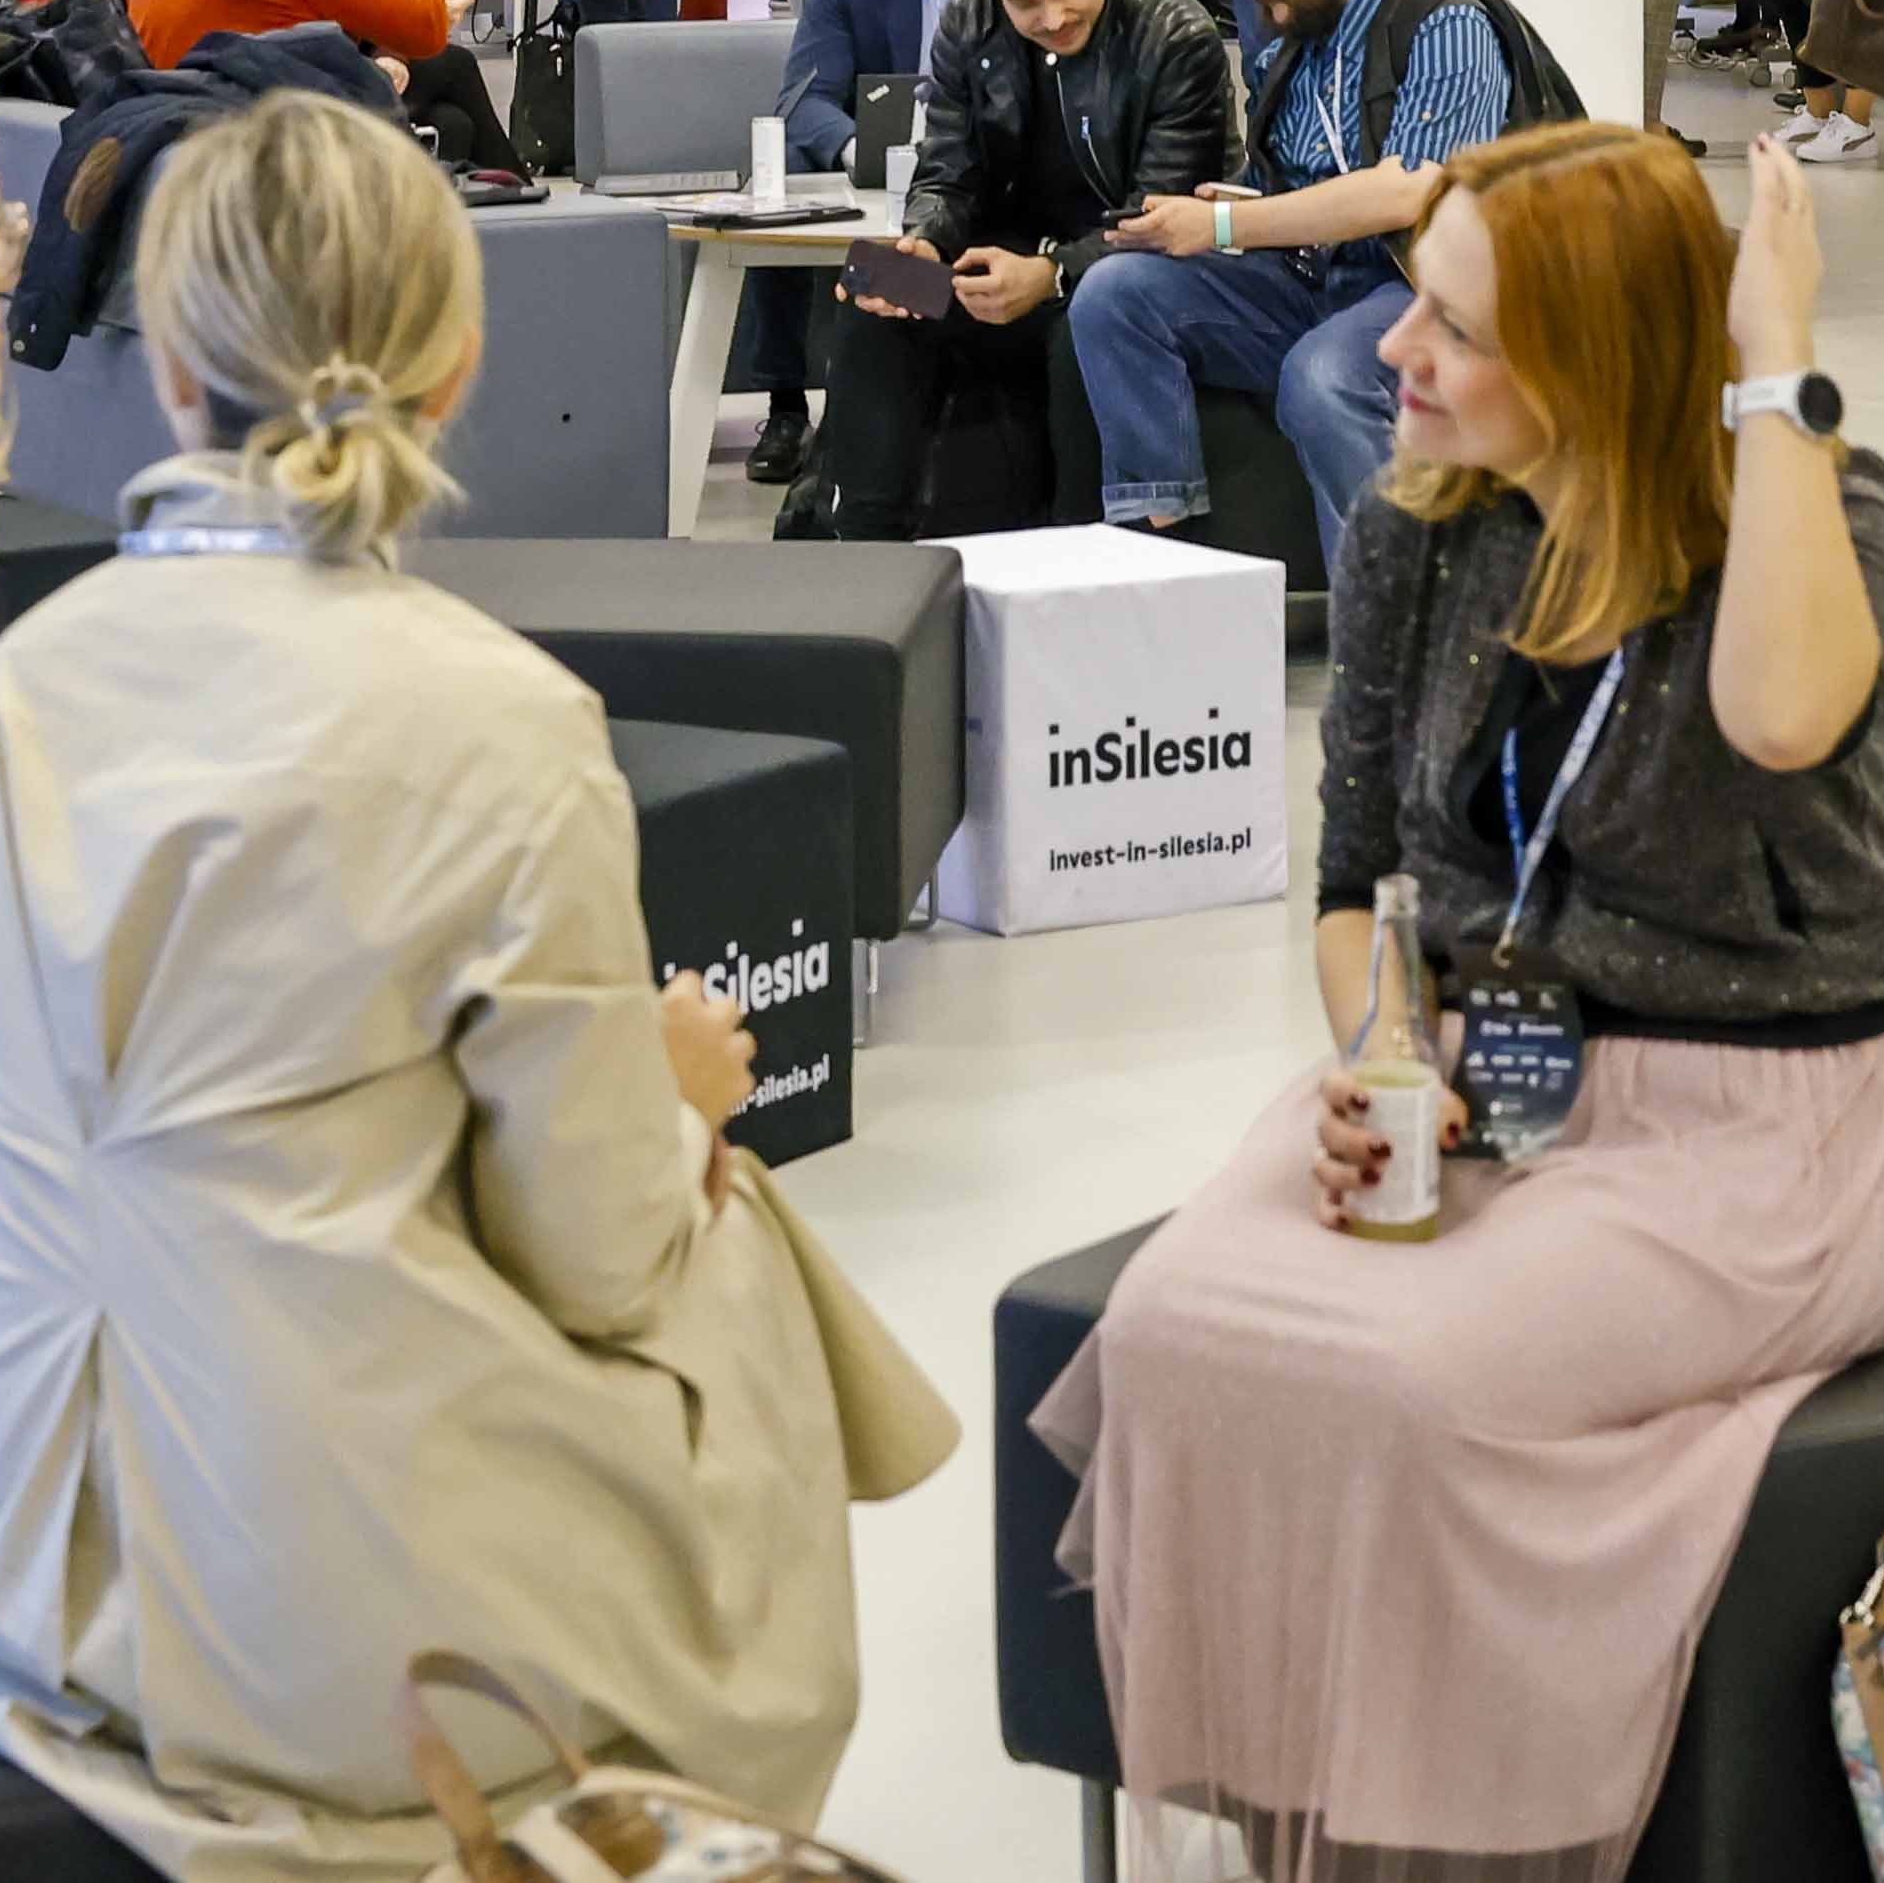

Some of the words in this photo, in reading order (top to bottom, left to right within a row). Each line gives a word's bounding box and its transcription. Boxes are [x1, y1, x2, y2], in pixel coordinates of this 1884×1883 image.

[1049, 707, 1251, 788] inSilesia
[1049, 826, 1252, 872] invest-in-silesia.pl
[664, 918, 830, 1016] Silesia
